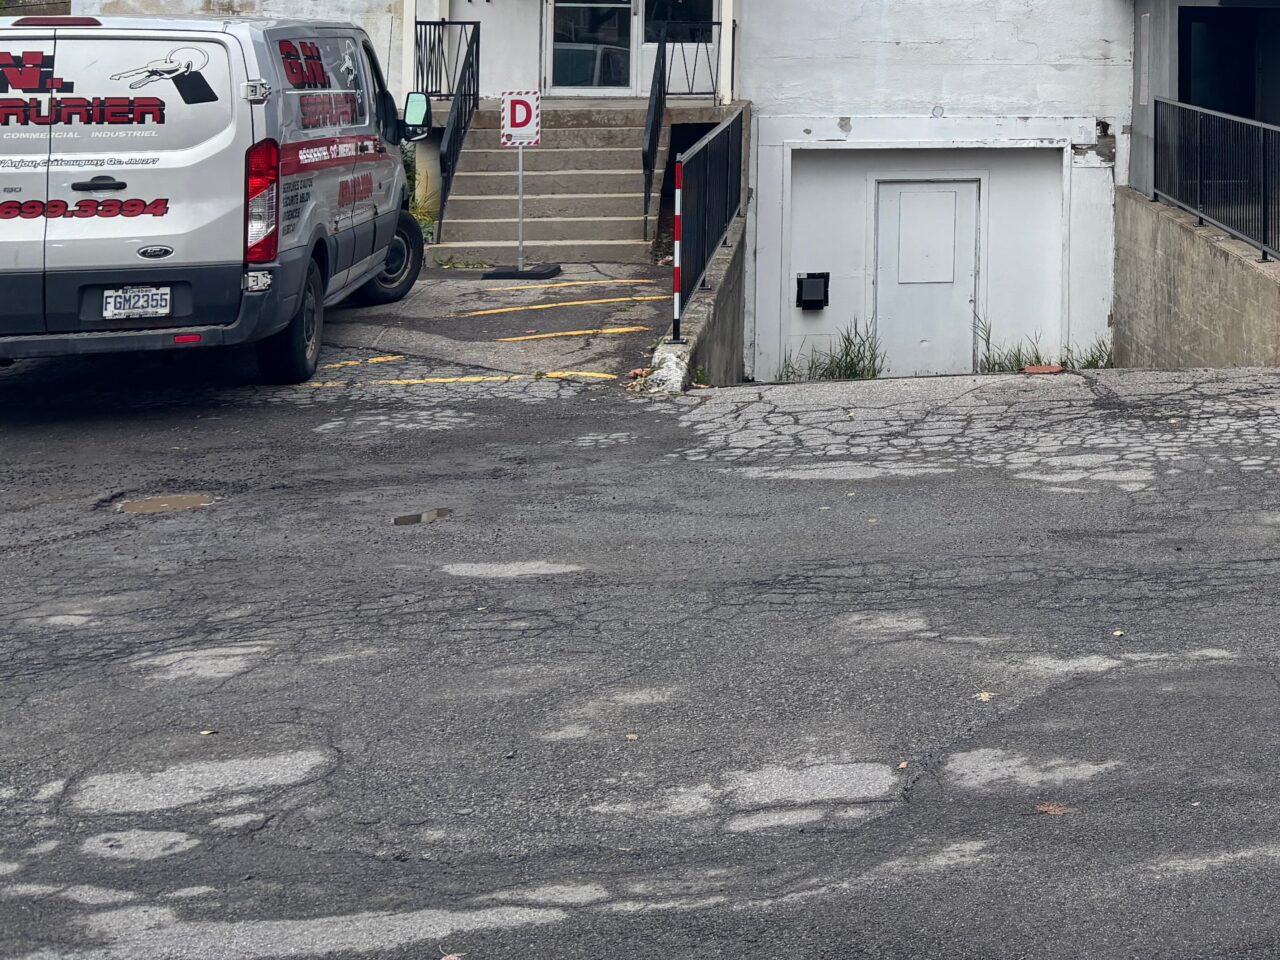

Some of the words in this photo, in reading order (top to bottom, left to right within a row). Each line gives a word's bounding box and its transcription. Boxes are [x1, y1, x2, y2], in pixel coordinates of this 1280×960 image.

[510, 100, 532, 128] D
[91, 130, 158, 138] INDUSTRIEL
[104, 293, 169, 311] FGM2355
